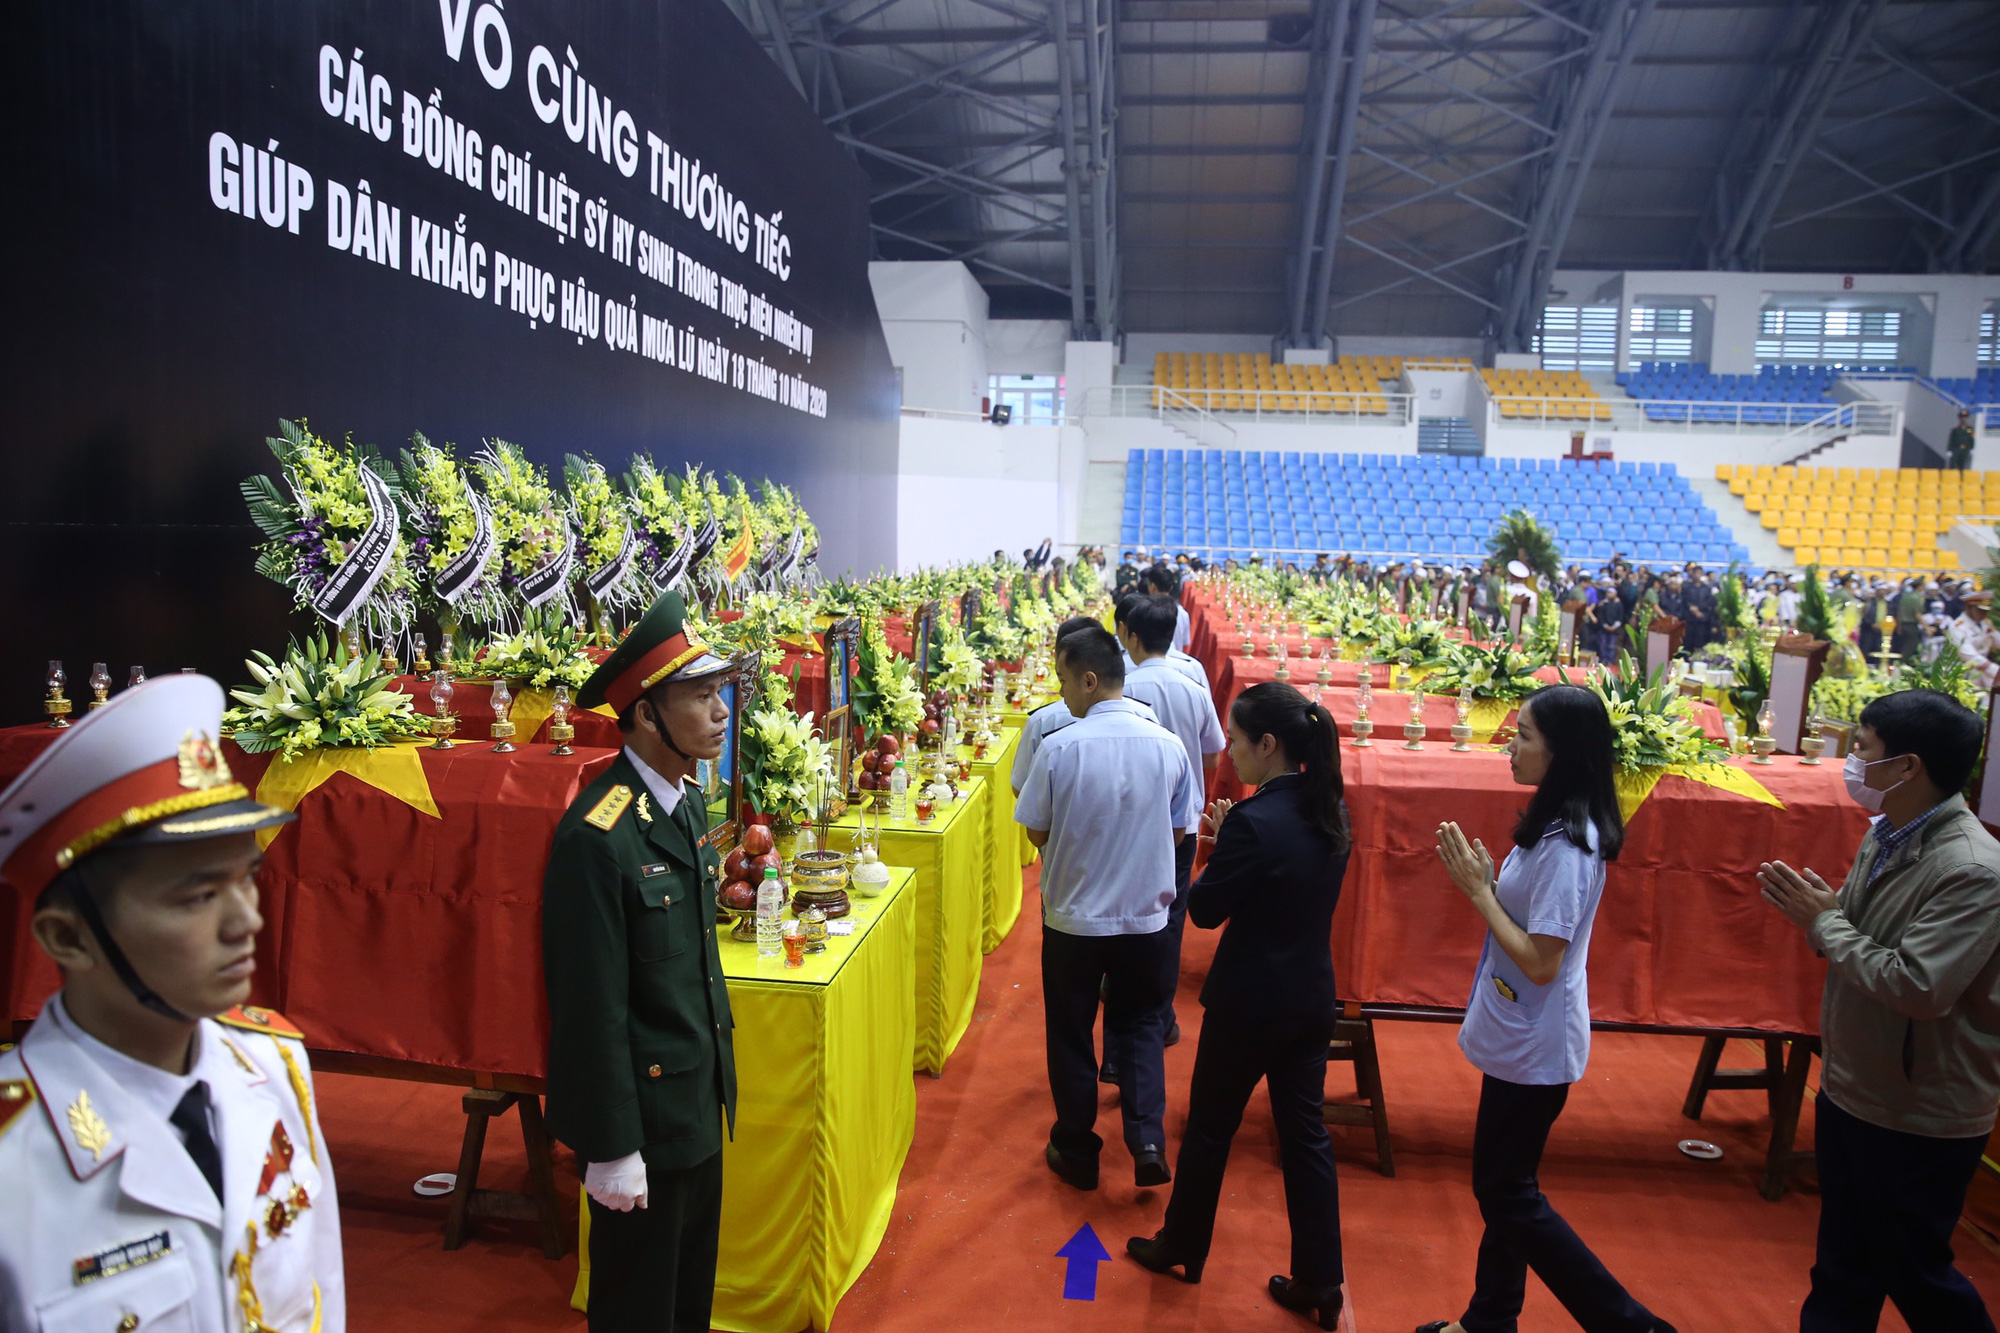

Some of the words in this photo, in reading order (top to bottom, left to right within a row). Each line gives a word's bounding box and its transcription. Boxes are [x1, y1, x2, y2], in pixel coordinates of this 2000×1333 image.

[208, 131, 314, 236] GIÚP
[327, 178, 401, 271] DÂN
[411, 212, 487, 300] KHẮC
[494, 250, 555, 330] PHỤC
[561, 276, 600, 346] HẬU
[604, 294, 639, 354] QUẢ
[642, 313, 676, 367] MƯA
[678, 325, 696, 373] LŨ
[697, 336, 730, 385] NGÀY
[732, 353, 746, 390] 18
[746, 355, 778, 402] THÁNG
[778, 372, 790, 406] 10
[790, 373, 811, 413] NĂM
[809, 384, 828, 419] 2020
[319, 44, 393, 143] CÁC
[402, 86, 483, 191] ĐỒNG
[490, 144, 532, 216] CHÍ
[537, 169, 580, 245] LIỆT
[584, 196, 609, 254] SỸ
[612, 213, 635, 267] HY
[637, 229, 675, 288] SINH
[676, 250, 719, 310] TRONG
[720, 276, 749, 329] THỰC
[749, 292, 774, 341] HIỆN
[774, 309, 802, 355] NHIỆM
[802, 323, 814, 364] VỤ
[527, 44, 639, 178] CÙNG
[646, 130, 750, 254] THƯƠNG
[753, 210, 792, 282] TIẾC
[364, 541, 386, 573] KÍNH
